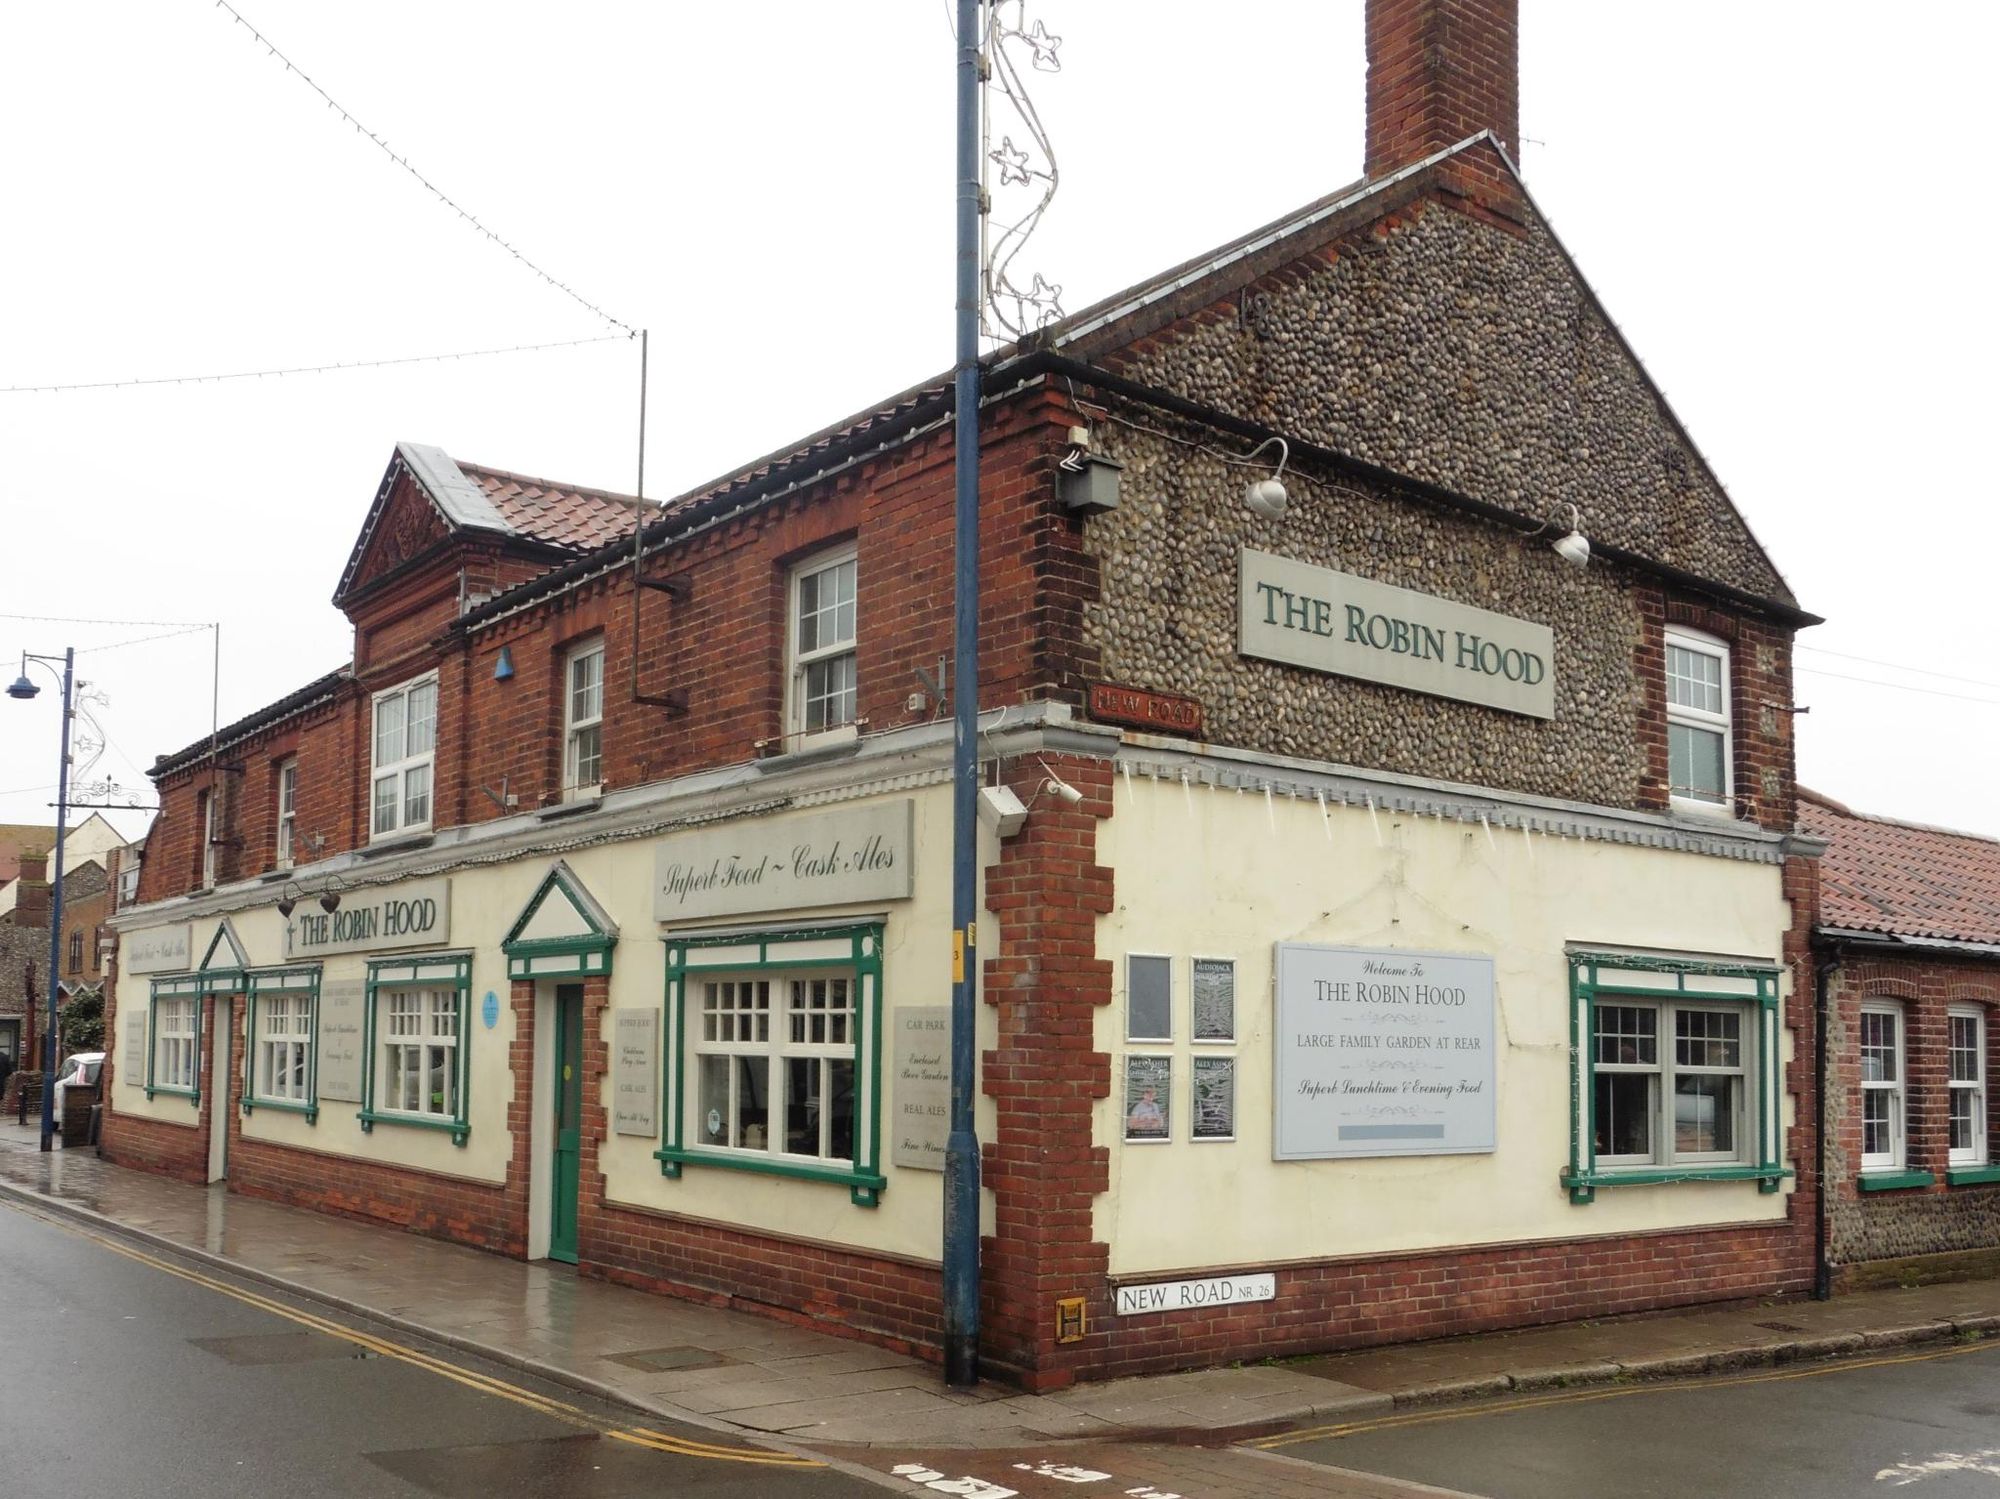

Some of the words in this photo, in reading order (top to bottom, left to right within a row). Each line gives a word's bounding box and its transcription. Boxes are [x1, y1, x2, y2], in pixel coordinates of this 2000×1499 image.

[1257, 581, 1333, 637] THE
[1345, 604, 1446, 663] ROBIN
[1455, 631, 1545, 686] HOOD
[663, 858, 720, 904] Superb
[720, 855, 768, 888] Food
[791, 841, 841, 879] Cask
[844, 835, 894, 873] Ales
[300, 914, 328, 946] THE
[332, 906, 379, 942] ROBIN
[383, 898, 436, 936] HOOD
[1361, 959, 1407, 976] Welcome
[1409, 962, 1425, 977] To
[1314, 980, 1350, 1001] THE
[1356, 982, 1410, 1004] ROBIN
[1415, 984, 1466, 1006] HOOD
[906, 1020, 923, 1030] CAR
[925, 1020, 945, 1031] PARK
[1297, 1034, 1335, 1048] LARGE
[1340, 1034, 1381, 1048] FAMILY
[1386, 1035, 1431, 1049] GARDEN
[1435, 1037, 1450, 1049] AT
[1454, 1037, 1481, 1050] REAR
[1297, 1079, 1338, 1100] Superb
[1341, 1079, 1399, 1095] Lunchtime
[1412, 1079, 1454, 1100] Evening
[1456, 1079, 1483, 1094] Food
[903, 1103, 924, 1115] REAL
[927, 1105, 946, 1116] ALES
[1123, 1287, 1167, 1311] NEW
[1180, 1281, 1233, 1305] ROAD
[1238, 1286, 1254, 1298] NR
[1259, 1285, 1270, 1297] 26
